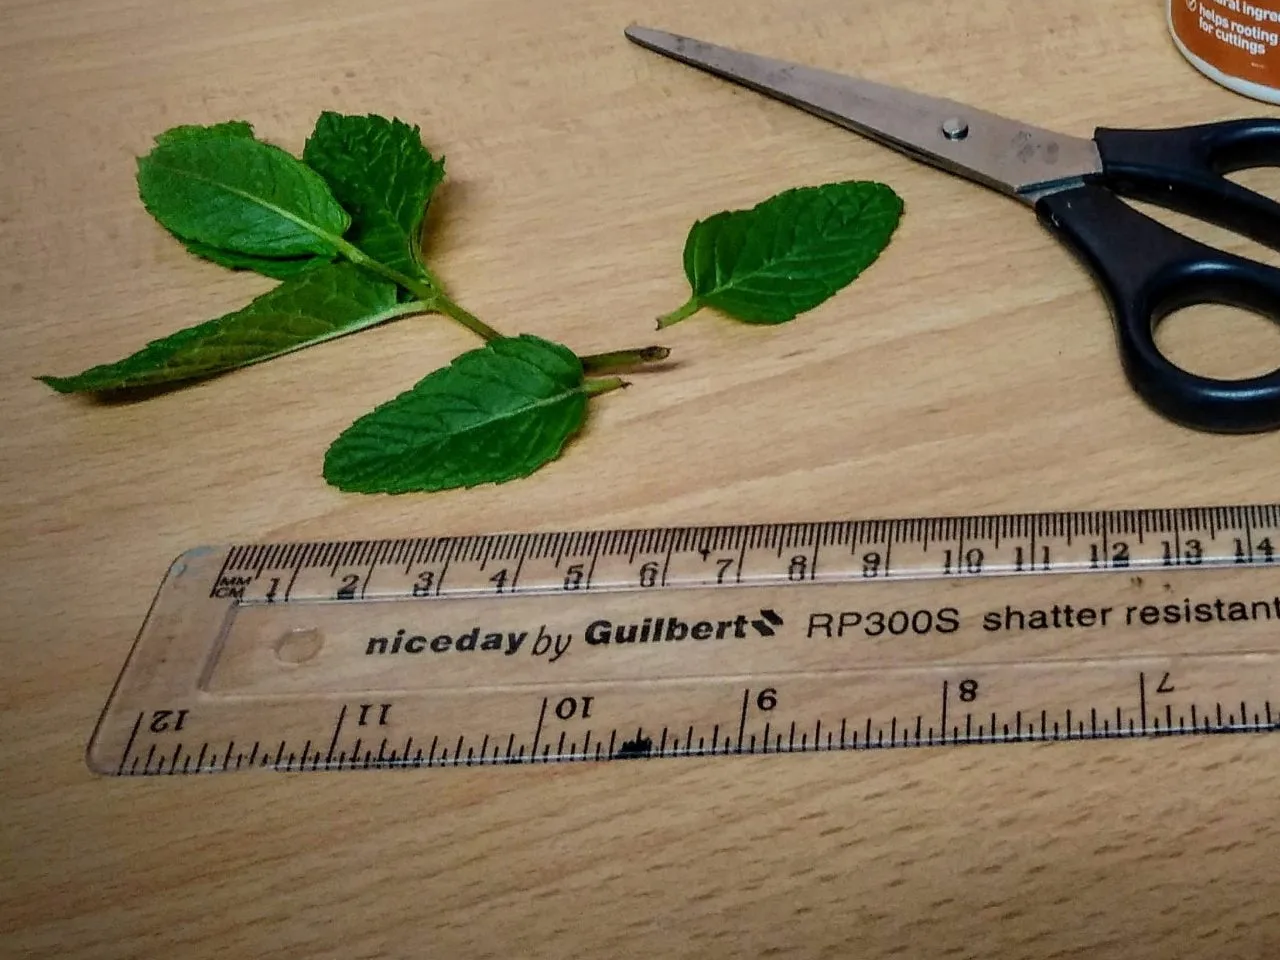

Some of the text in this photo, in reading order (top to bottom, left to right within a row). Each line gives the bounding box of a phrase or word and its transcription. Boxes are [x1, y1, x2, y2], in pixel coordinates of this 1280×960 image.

[1199, 2, 1229, 28] helps
[1231, 20, 1279, 46] rooting
[1199, 16, 1266, 55] for cuttings
[265, 577, 281, 602] 1
[337, 573, 360, 600] 2
[413, 571, 435, 597] 3
[489, 568, 508, 593] 4
[563, 564, 584, 590] 5
[639, 561, 659, 587] 6
[716, 558, 735, 584] 7
[788, 555, 808, 581] 8
[862, 552, 881, 578] 9
[943, 548, 985, 574] 10
[1014, 545, 1051, 571] 11
[1089, 542, 1130, 568] 12
[1161, 540, 1202, 565] 13
[1233, 537, 1275, 563] 14
[365, 627, 529, 656] niceday
[531, 624, 572, 662] by
[585, 615, 747, 646] Guilbert
[807, 607, 960, 639] RP300S
[983, 604, 1112, 632] shatter
